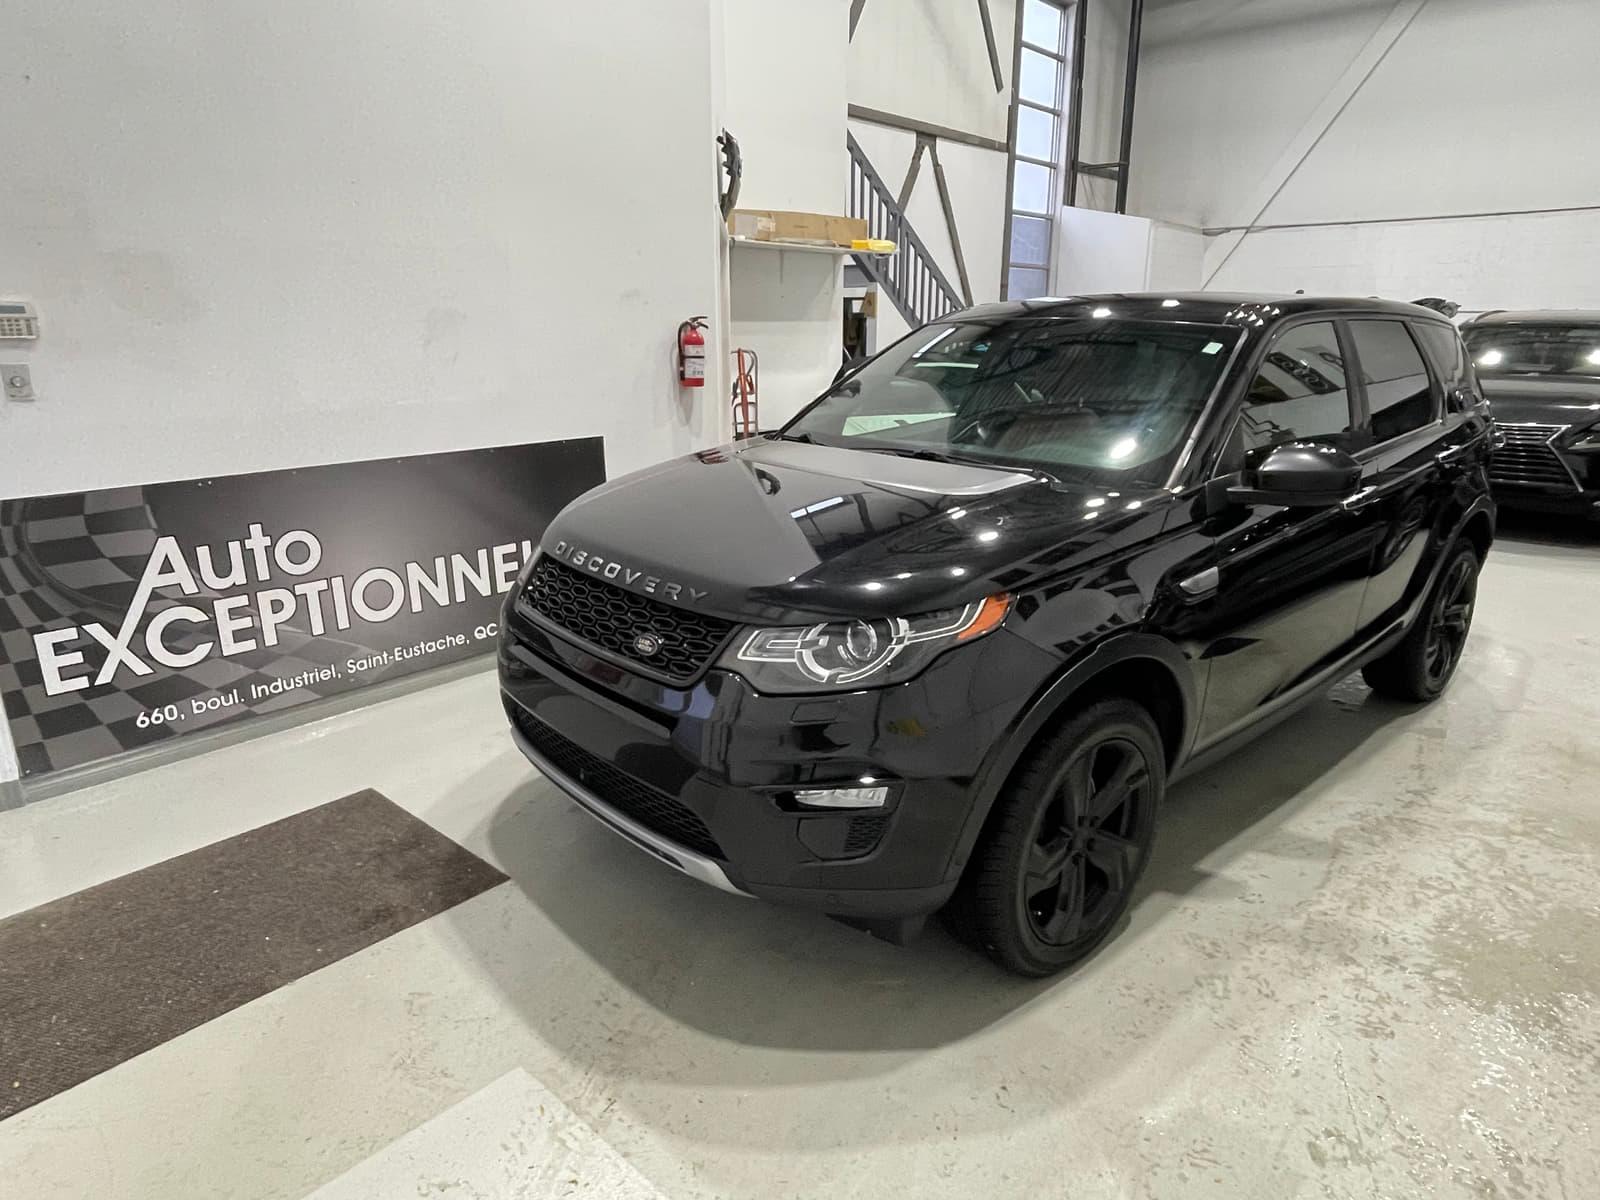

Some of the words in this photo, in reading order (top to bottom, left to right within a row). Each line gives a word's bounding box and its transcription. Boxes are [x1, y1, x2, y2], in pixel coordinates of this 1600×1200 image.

[147, 523, 322, 595] Auto
[555, 541, 708, 601] DISCOVERY
[136, 704, 186, 728] 660,
[191, 689, 245, 714] boul.
[250, 664, 342, 700] Industriel,
[346, 635, 470, 673] Saint-Eustache,
[474, 623, 498, 639] QC
